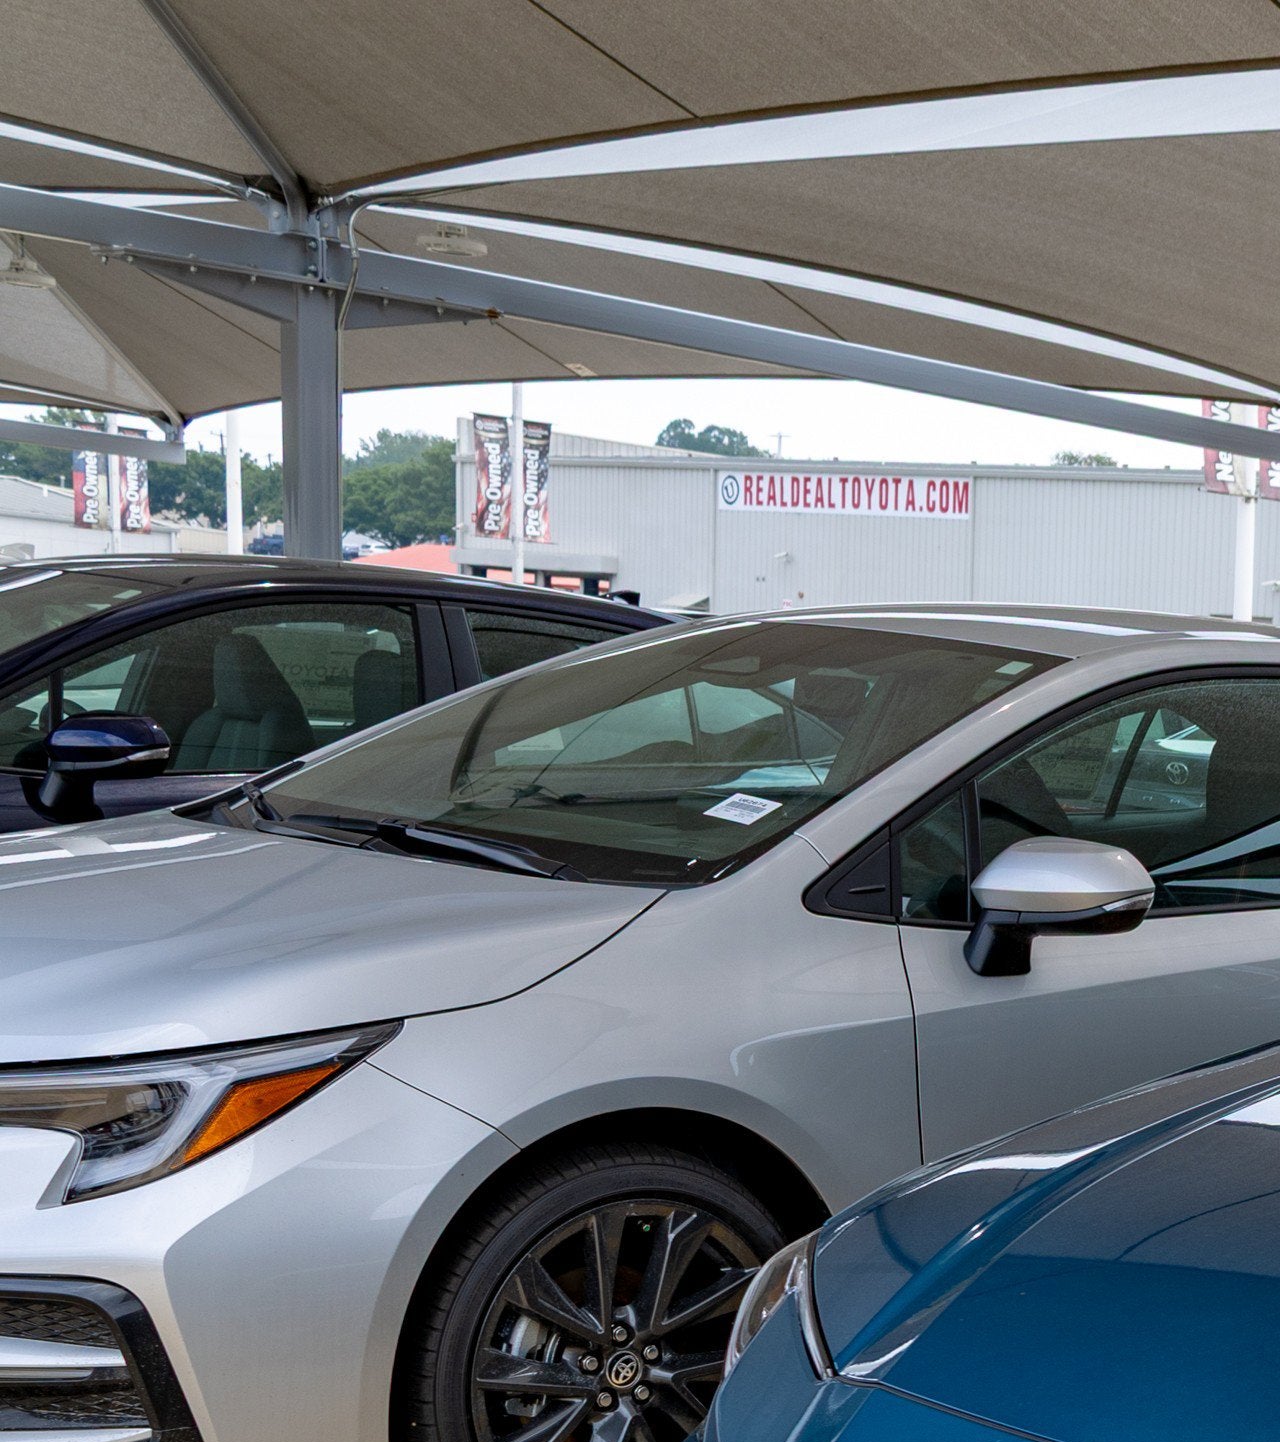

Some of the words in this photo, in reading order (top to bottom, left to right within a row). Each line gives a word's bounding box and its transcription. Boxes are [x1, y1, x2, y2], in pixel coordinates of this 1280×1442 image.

[484, 442, 502, 500] Owned
[523, 448, 540, 506] Owned
[743, 475, 969, 514] REALDEALTOYOTA.COM
[83, 499, 99, 523] Pre
[126, 504, 141, 529] Pre
[484, 503, 500, 531] Pre
[525, 509, 540, 536] Pre
